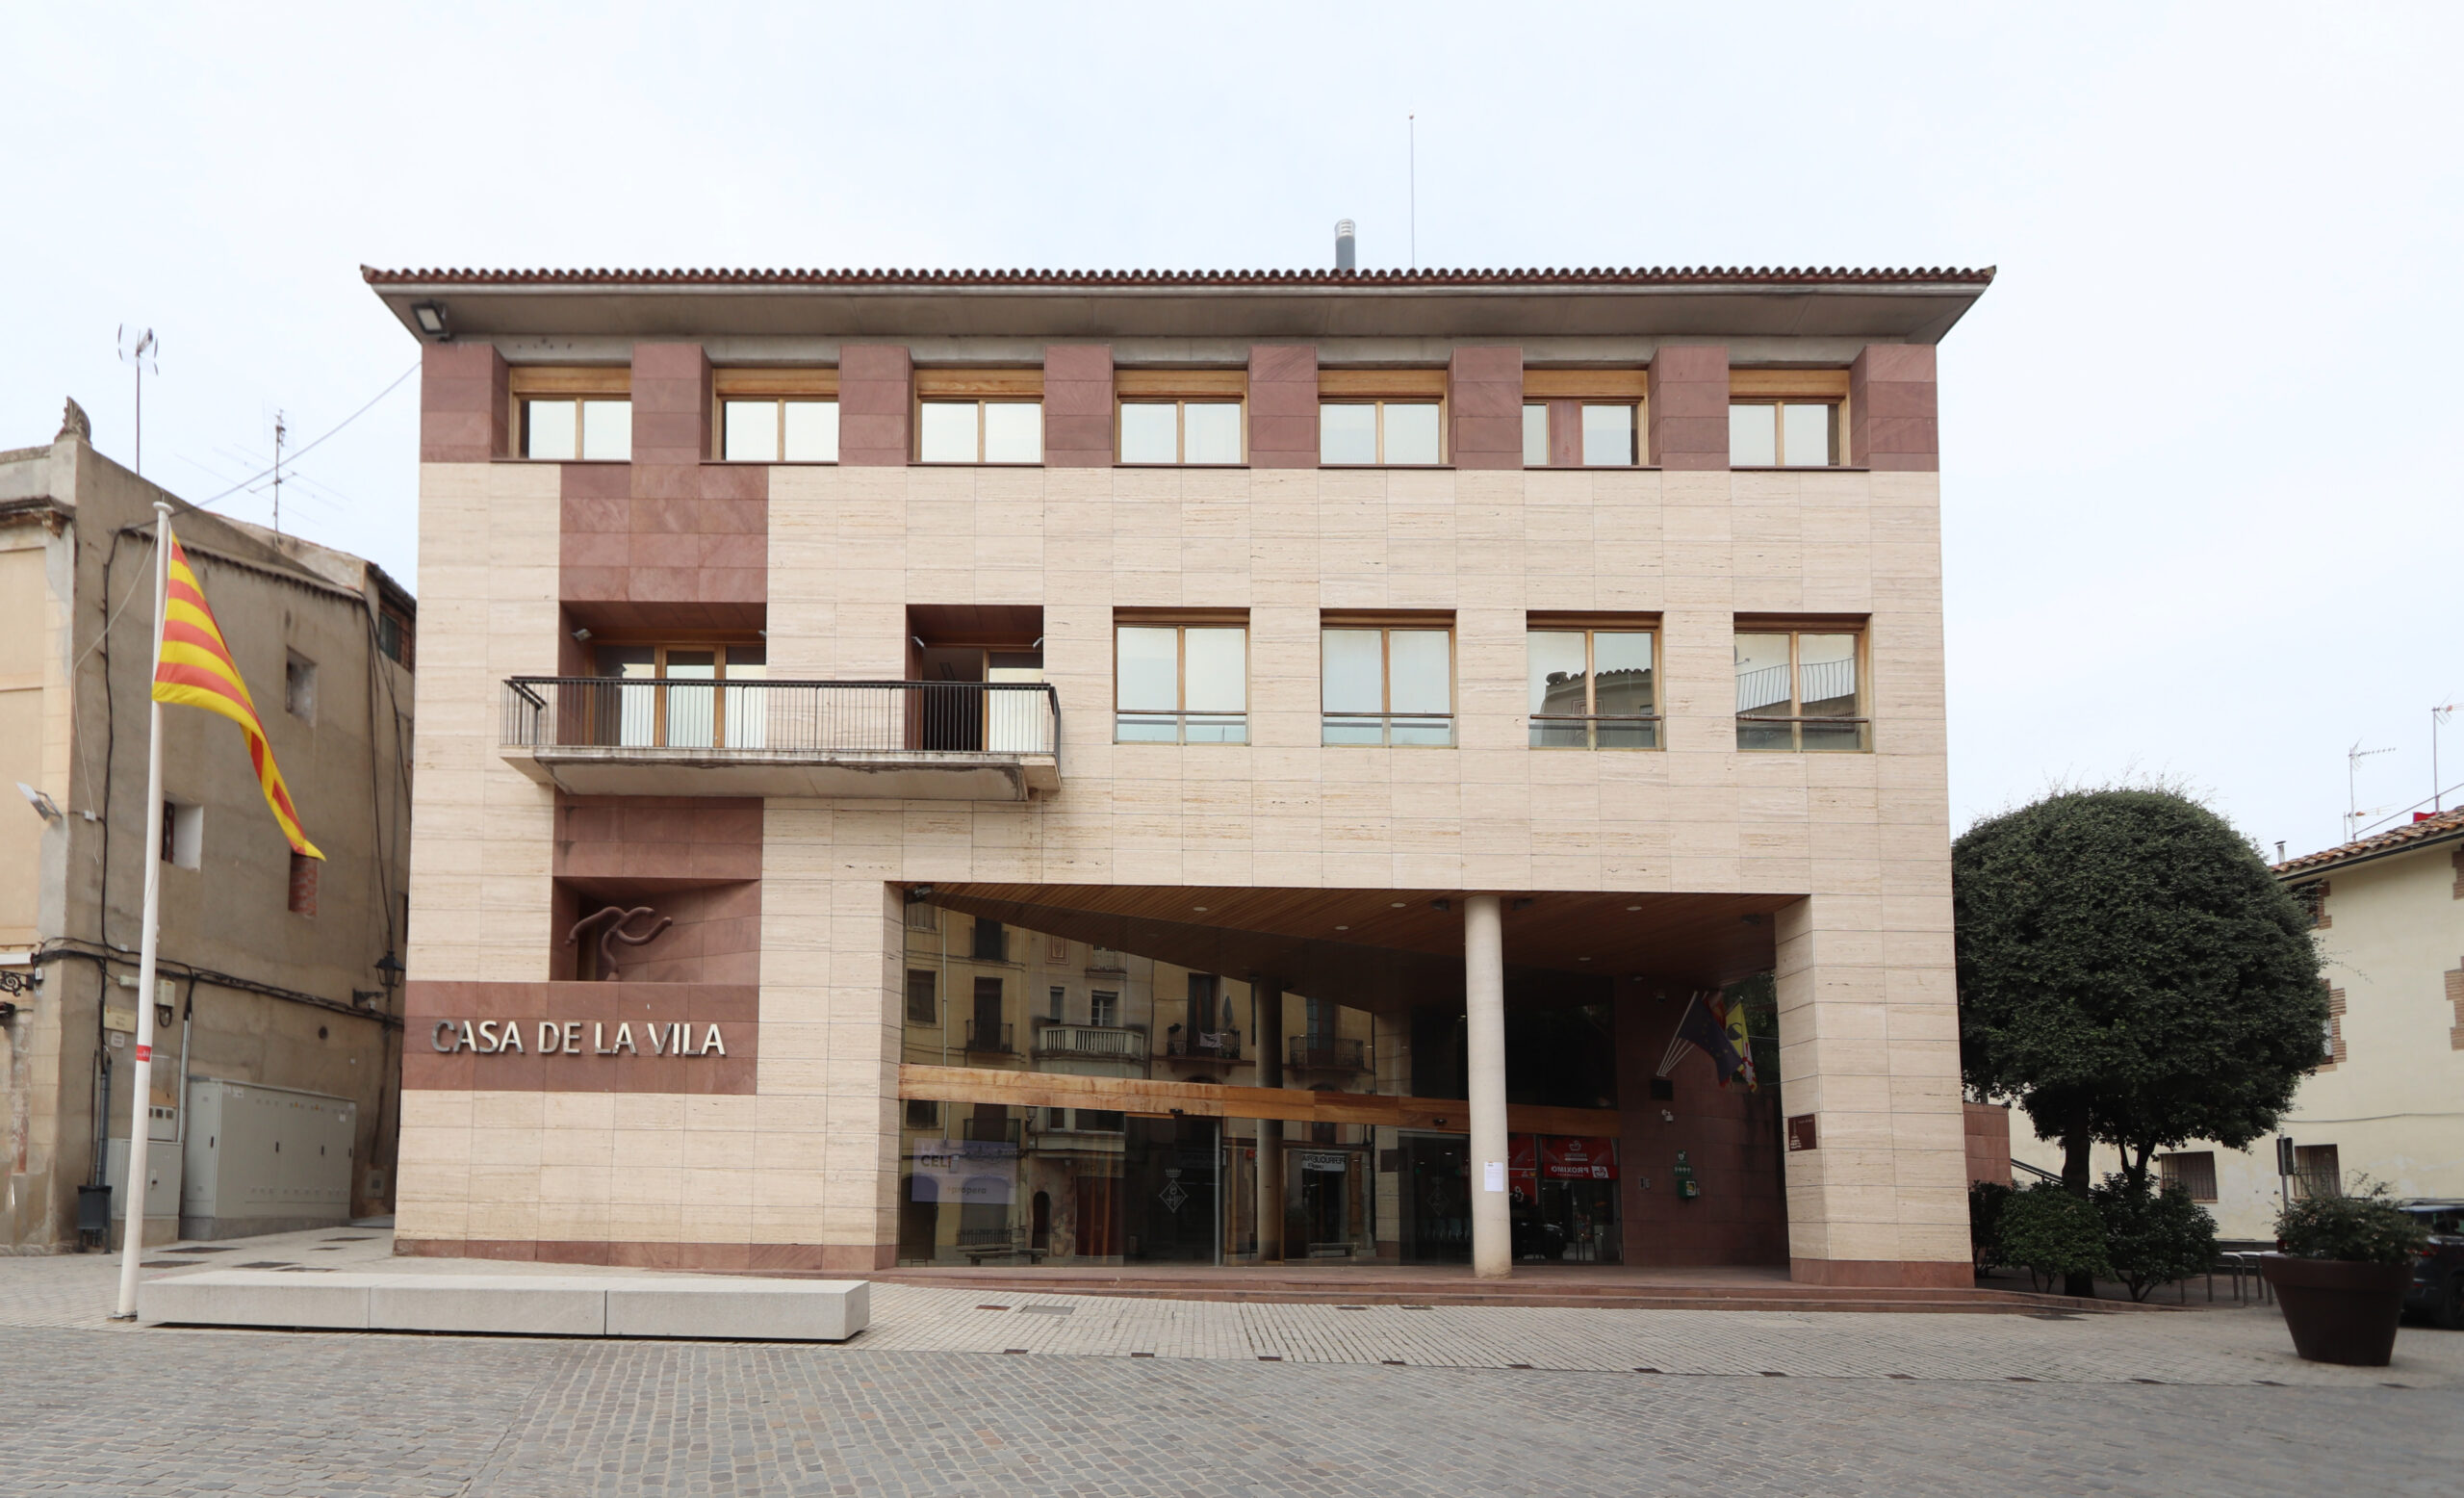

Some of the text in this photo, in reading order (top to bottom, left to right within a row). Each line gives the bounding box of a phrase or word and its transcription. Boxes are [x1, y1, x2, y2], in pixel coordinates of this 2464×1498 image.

[431, 1020, 726, 1056] CASA DE LA VILA
